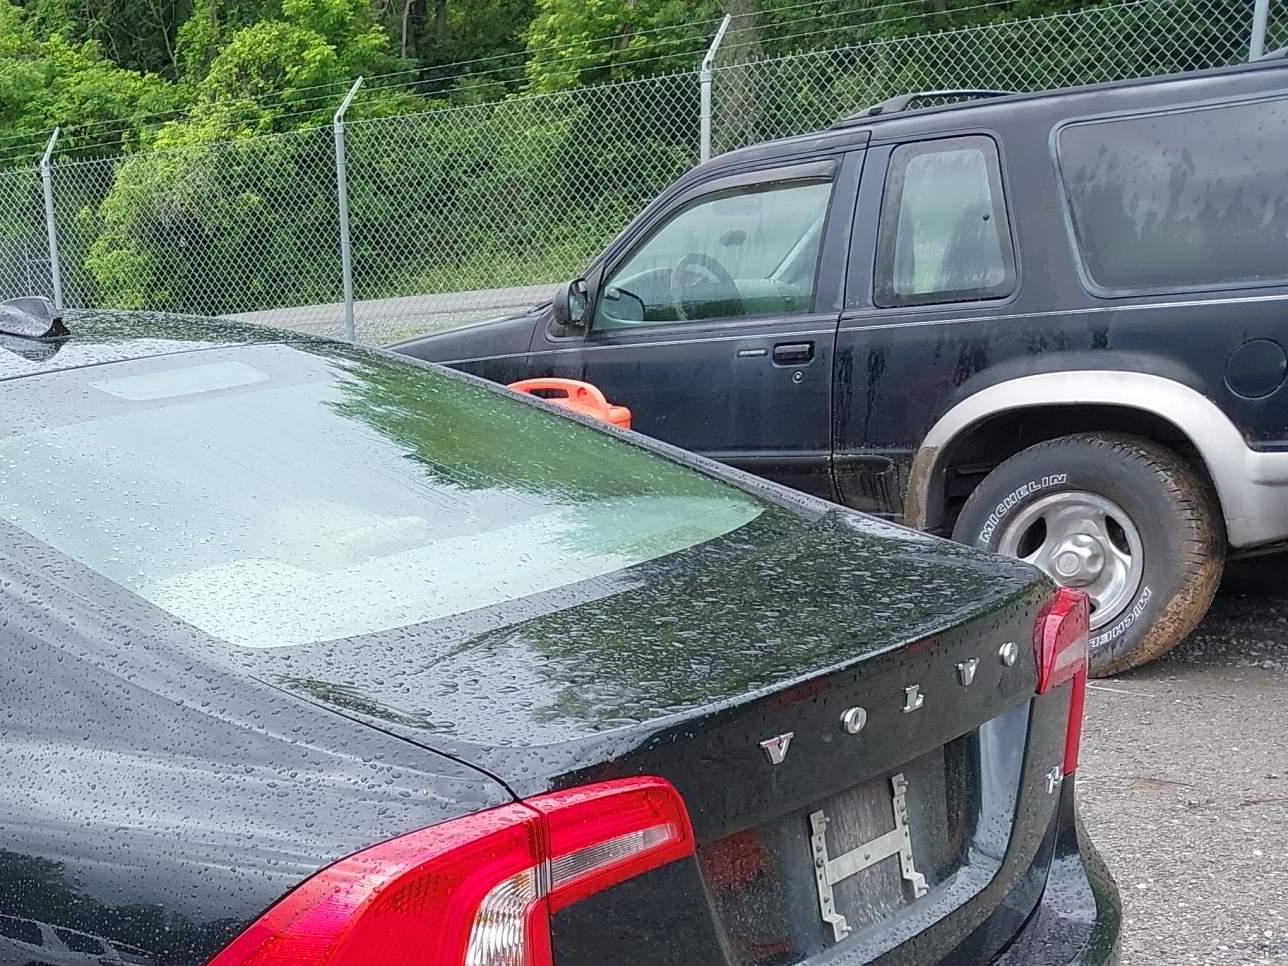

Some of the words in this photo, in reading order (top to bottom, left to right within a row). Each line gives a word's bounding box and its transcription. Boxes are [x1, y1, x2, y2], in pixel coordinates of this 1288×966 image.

[979, 473, 1067, 544] MICHELIN
[1088, 586, 1153, 649] MICHEL
[759, 640, 1019, 766] VOLVO
